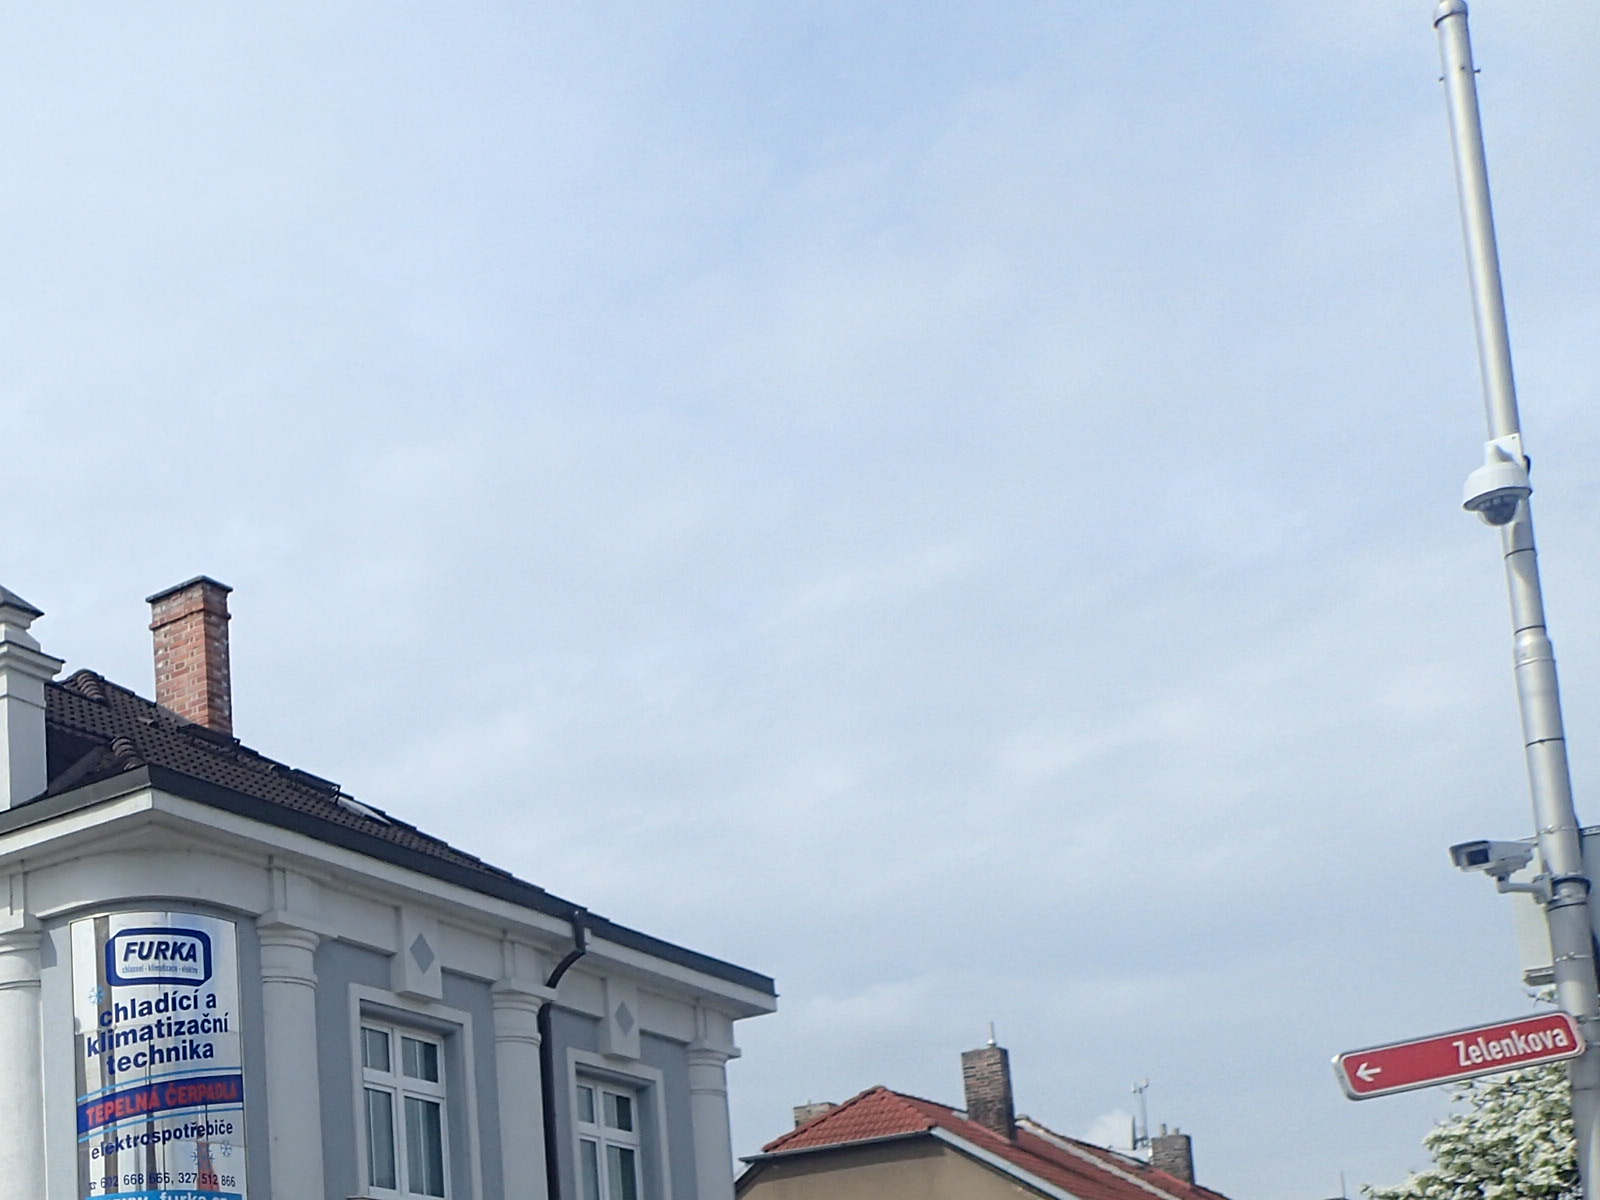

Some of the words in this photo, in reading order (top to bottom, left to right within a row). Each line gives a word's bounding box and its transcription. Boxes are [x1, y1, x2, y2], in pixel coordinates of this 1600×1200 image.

[123, 941, 197, 962] FURKA
[100, 989, 199, 1027] chladící
[206, 993, 216, 1009] a
[87, 1012, 229, 1057] klimatizační
[1452, 1028, 1568, 1067] Zelenkova
[107, 1040, 214, 1075] technika
[86, 1085, 160, 1127] TEPELNÁ
[166, 1082, 237, 1108] ČERPADLA
[91, 1119, 233, 1160] elektrospotřebiče
[101, 1176, 119, 1188] 602
[124, 1174, 144, 1185] 668
[178, 1172, 198, 1184] 327
[201, 1174, 219, 1186] 512
[221, 1175, 236, 1187] 866
